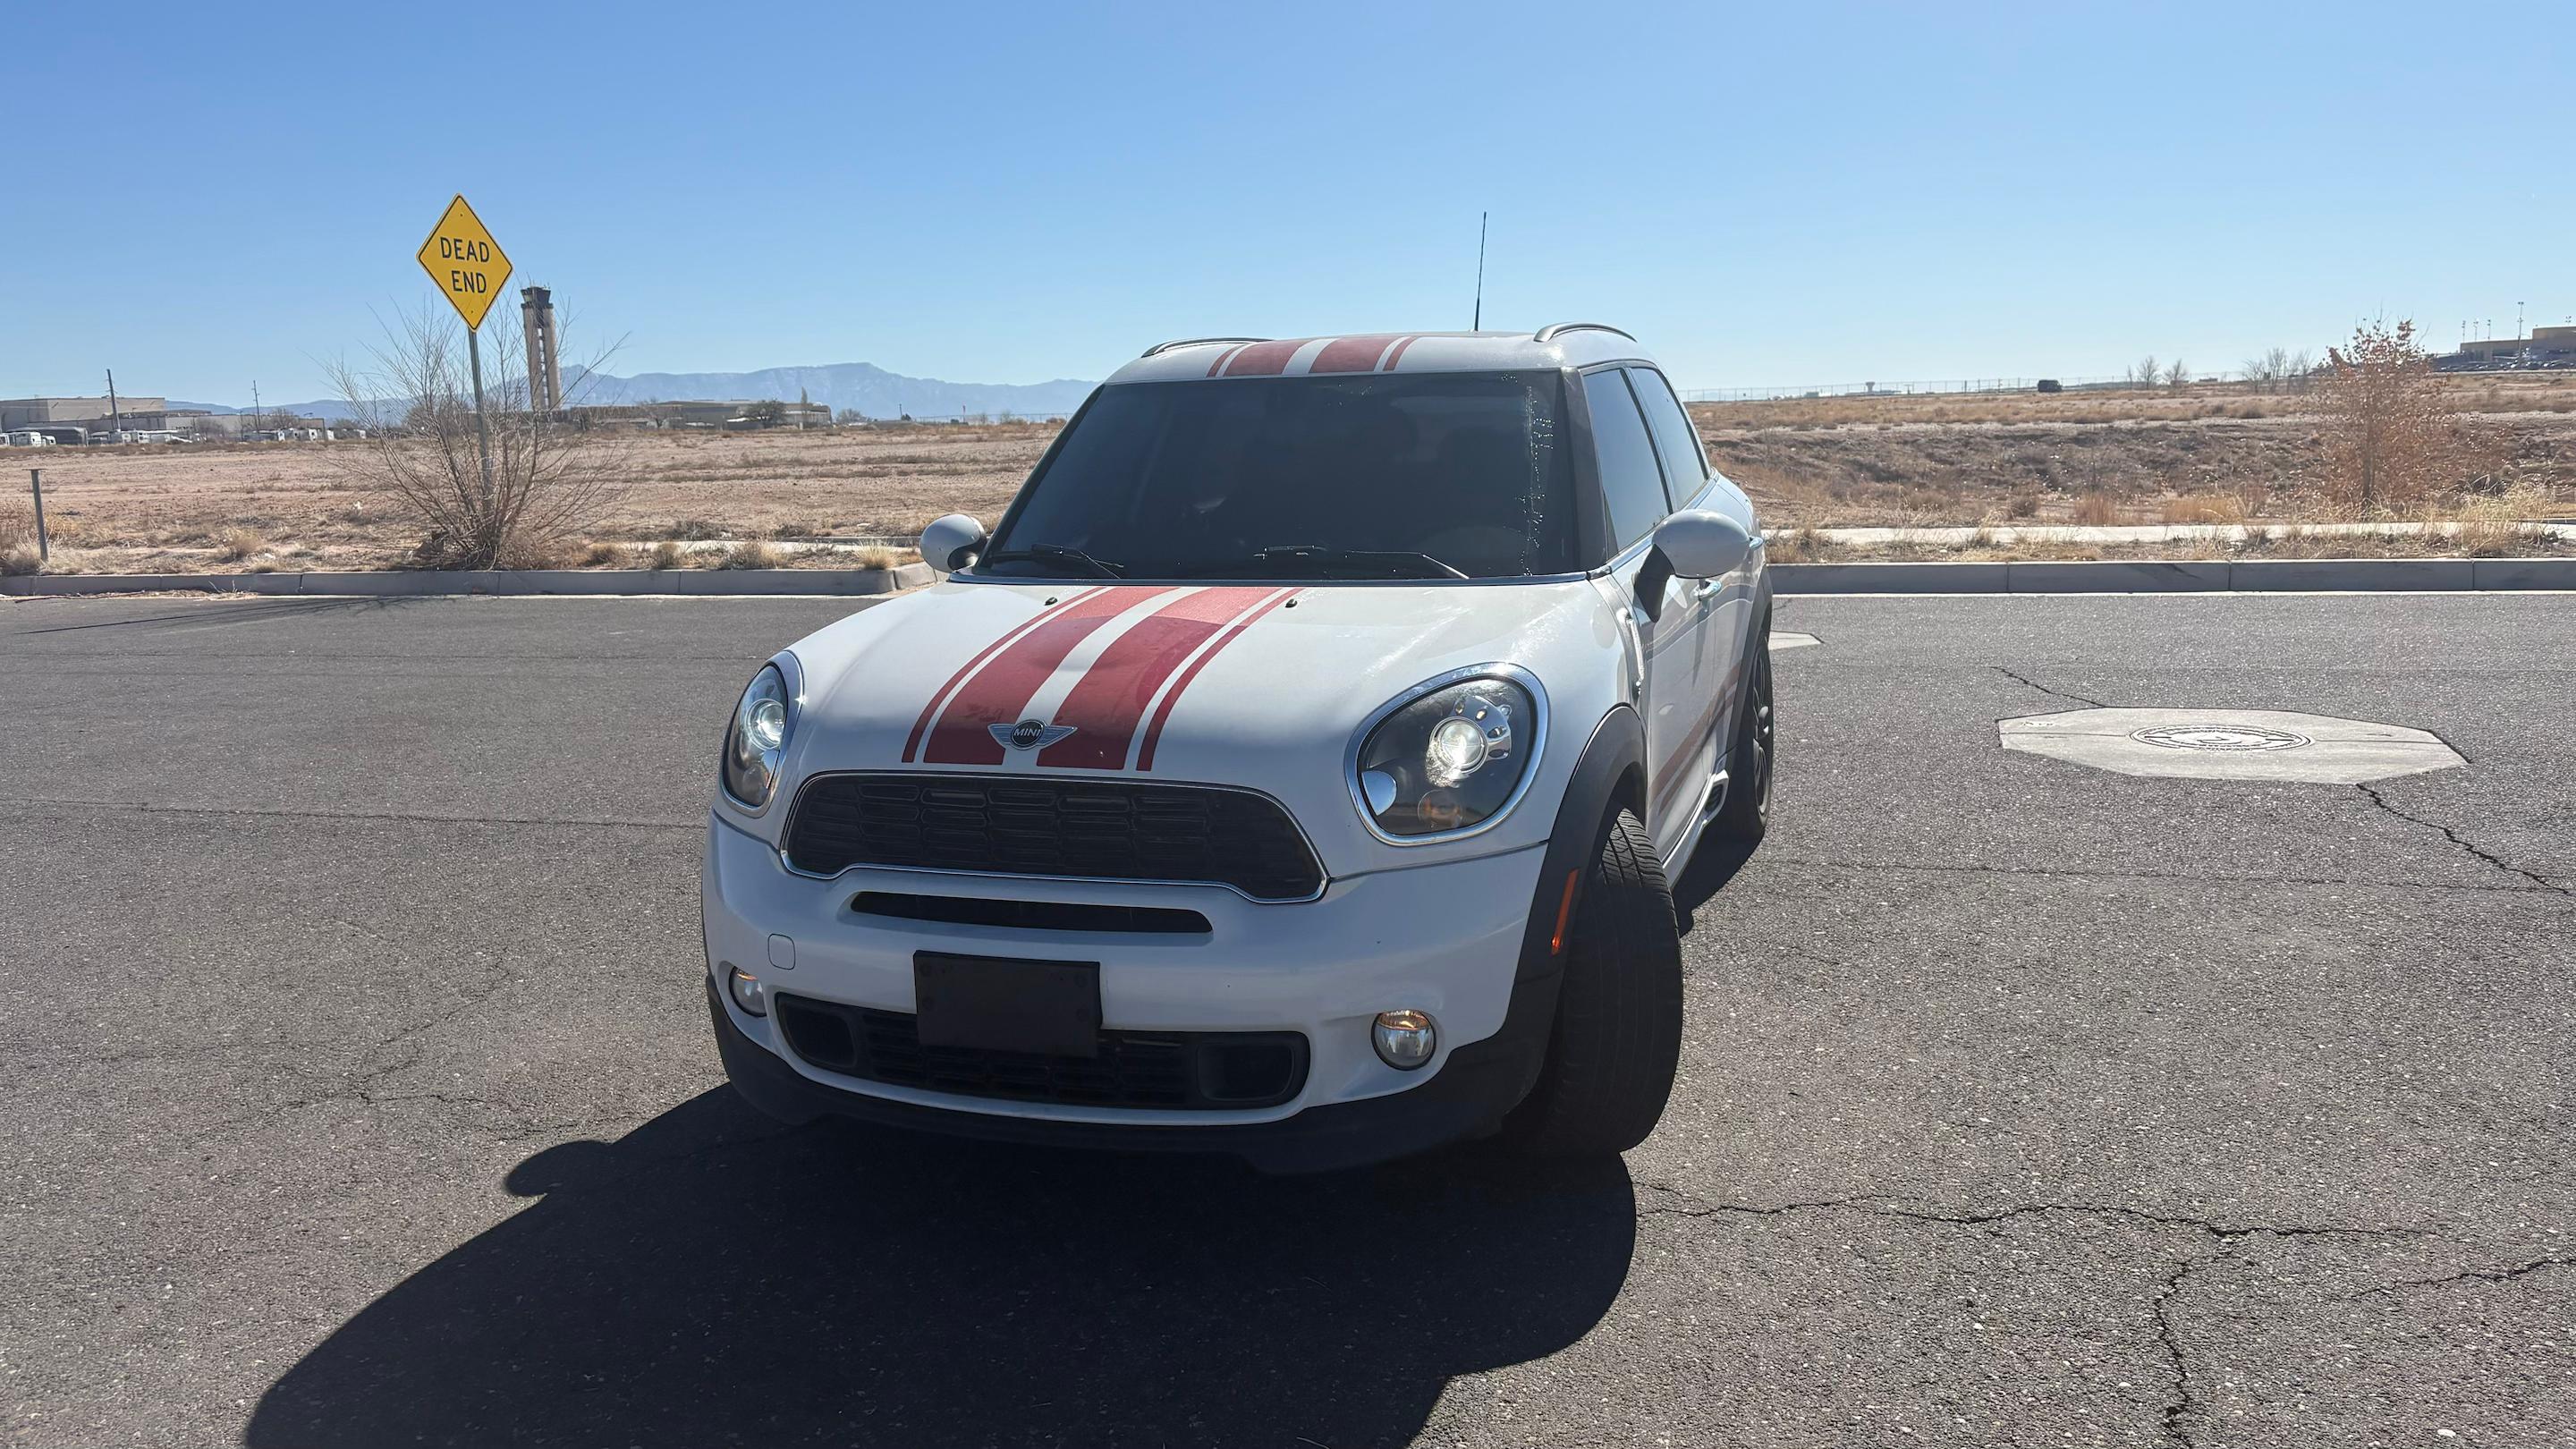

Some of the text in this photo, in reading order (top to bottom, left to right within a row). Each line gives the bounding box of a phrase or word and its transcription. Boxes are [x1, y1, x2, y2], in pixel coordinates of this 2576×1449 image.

[440, 237, 489, 263] DEAD
[451, 270, 487, 293] END
[1013, 728, 1041, 737] MINI
